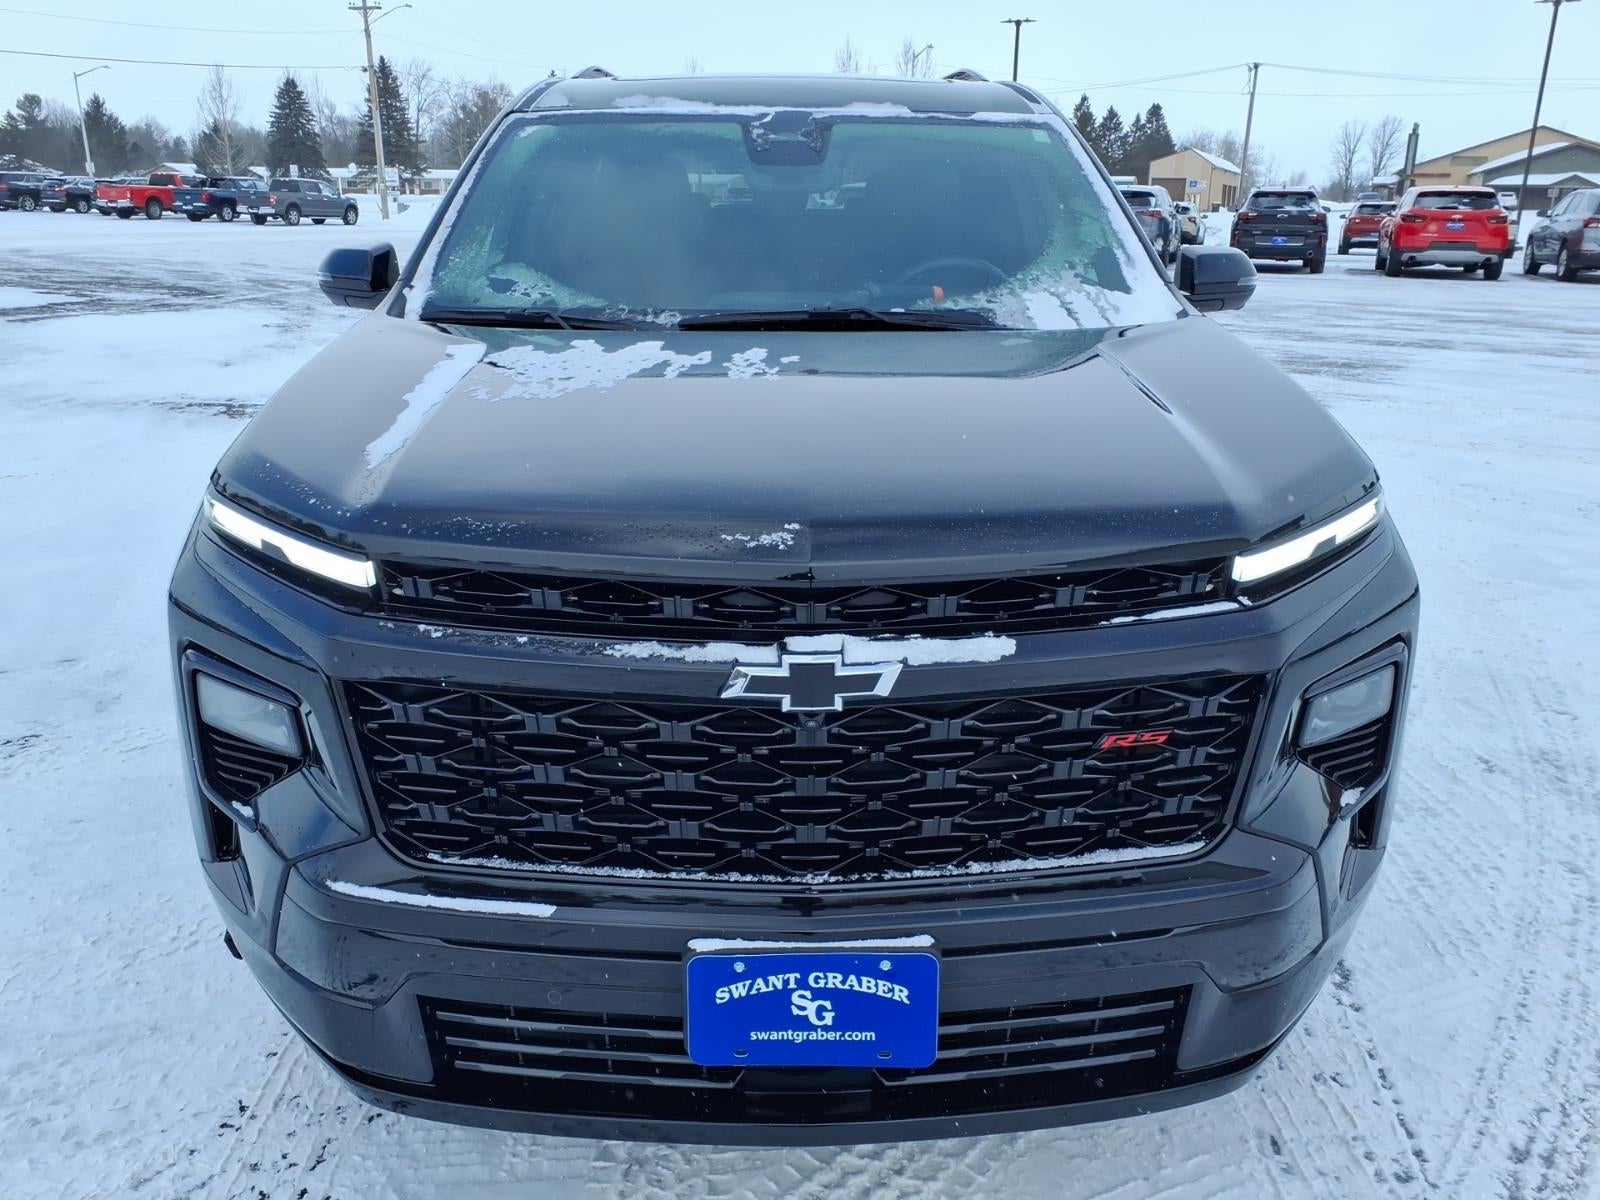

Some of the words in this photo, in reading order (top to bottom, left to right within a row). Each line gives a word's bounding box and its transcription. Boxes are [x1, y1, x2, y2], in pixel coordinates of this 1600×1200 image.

[1097, 728, 1173, 750] RS
[715, 973, 801, 1005] SWANT
[808, 972, 911, 1005] GRABER
[791, 989, 835, 1026] SG
[750, 1028, 876, 1043] swantgraber.com
